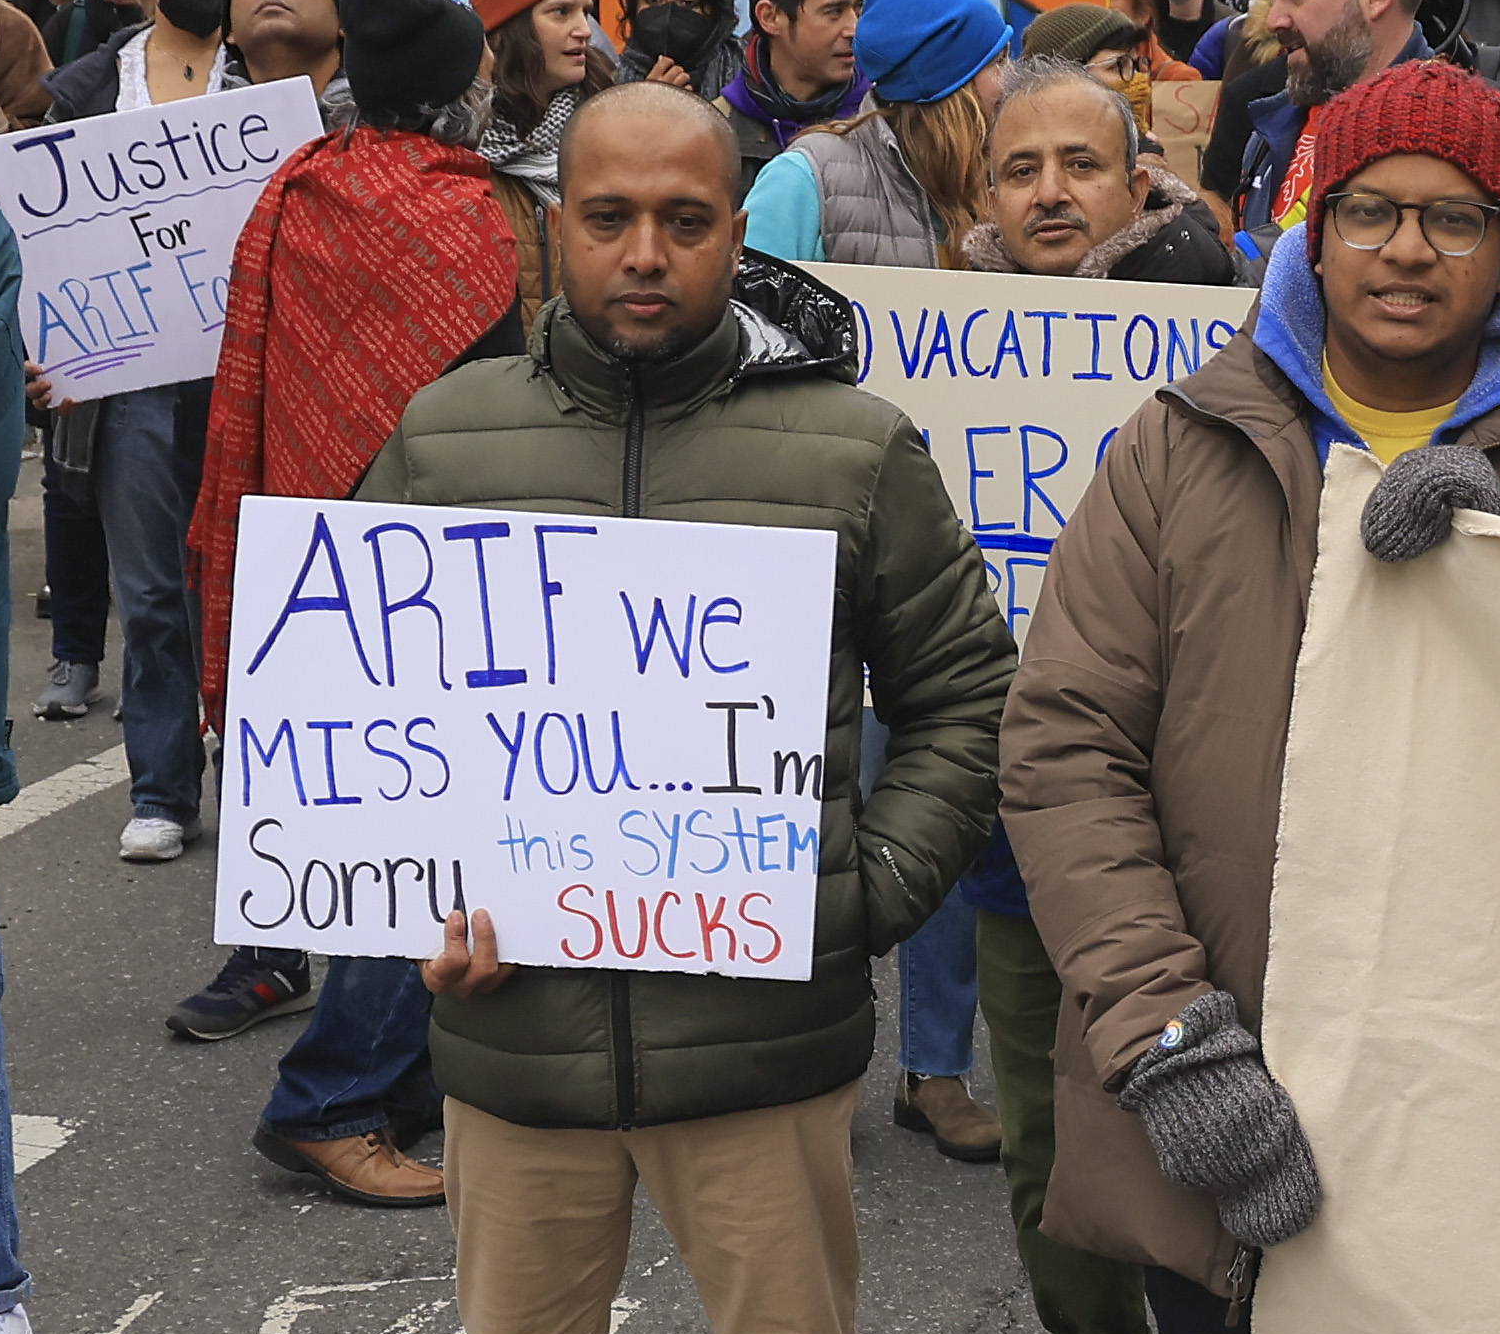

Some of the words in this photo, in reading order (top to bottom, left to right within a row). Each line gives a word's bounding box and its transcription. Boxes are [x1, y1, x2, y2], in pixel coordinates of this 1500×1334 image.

[13, 112, 280, 219] Justice
[129, 212, 191, 258] For
[37, 261, 159, 364] ARIF
[246, 511, 597, 690] ARIF
[239, 717, 451, 807] MISS
[239, 816, 468, 956] Sorry
[498, 814, 594, 873] this
[557, 883, 782, 965] SUCKS
